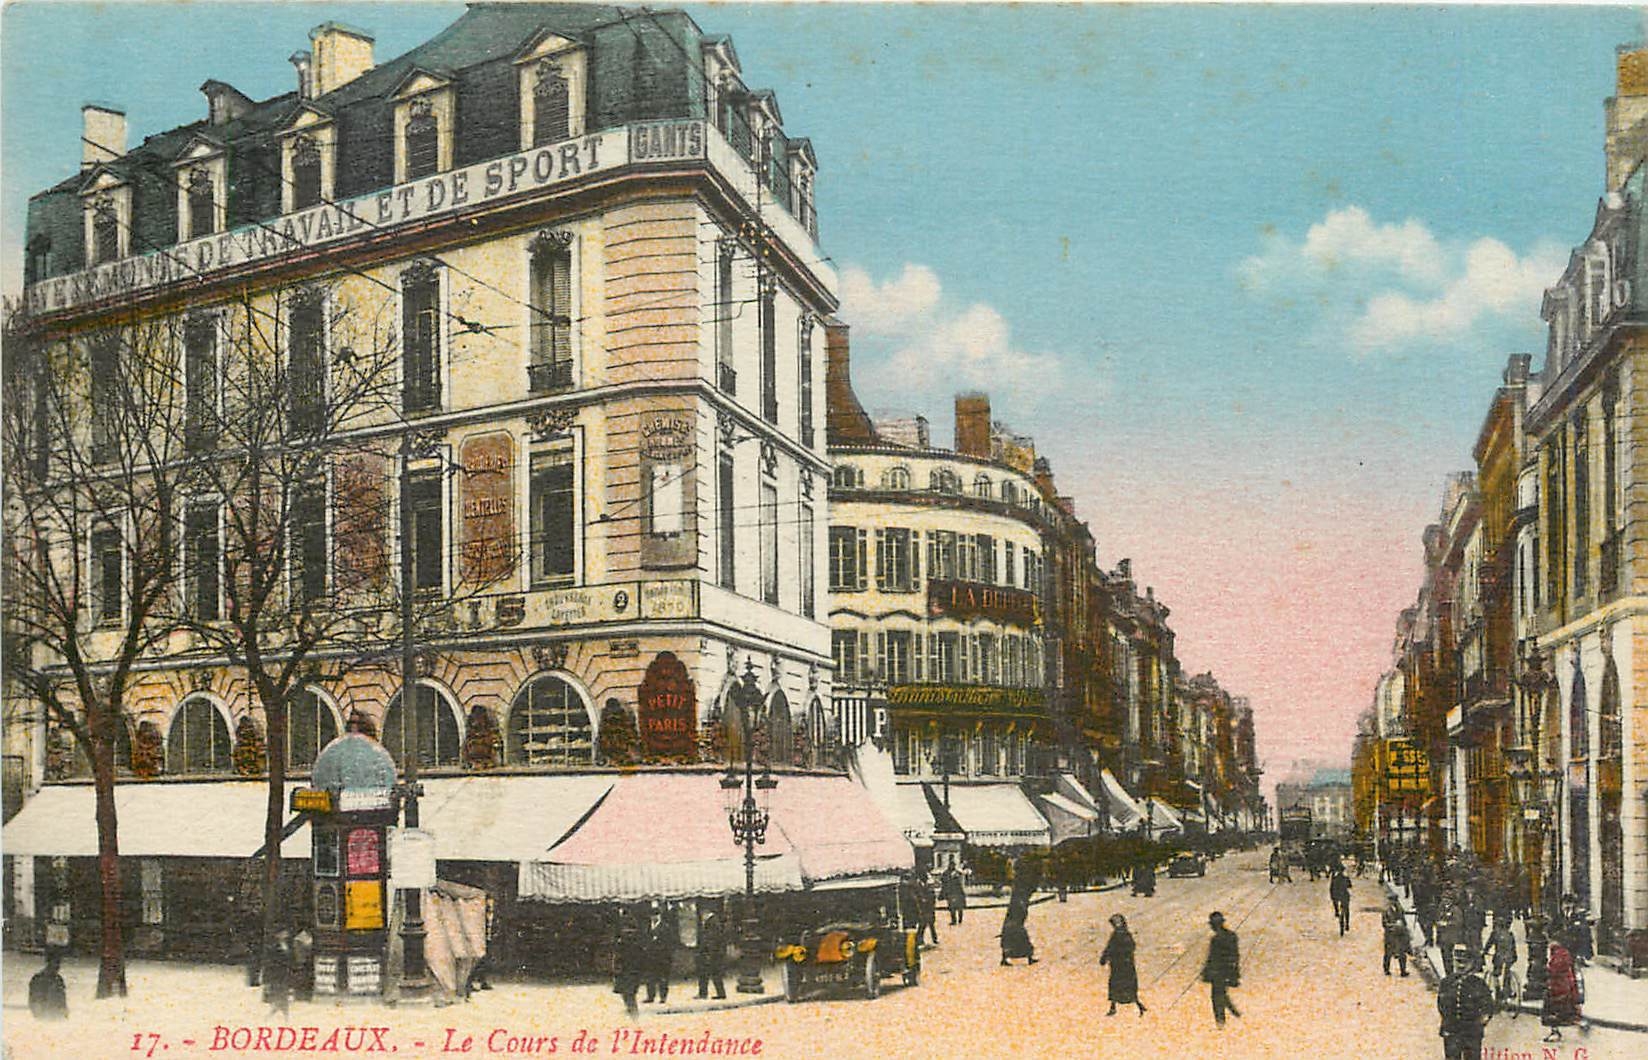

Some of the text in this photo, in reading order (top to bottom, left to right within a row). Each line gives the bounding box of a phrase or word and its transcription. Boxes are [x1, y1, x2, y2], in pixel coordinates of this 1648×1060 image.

[197, 234, 233, 271] DE
[238, 200, 362, 258] TRAVAIL
[376, 185, 415, 224] ET
[426, 170, 469, 212] DE
[484, 134, 603, 199] SPORT
